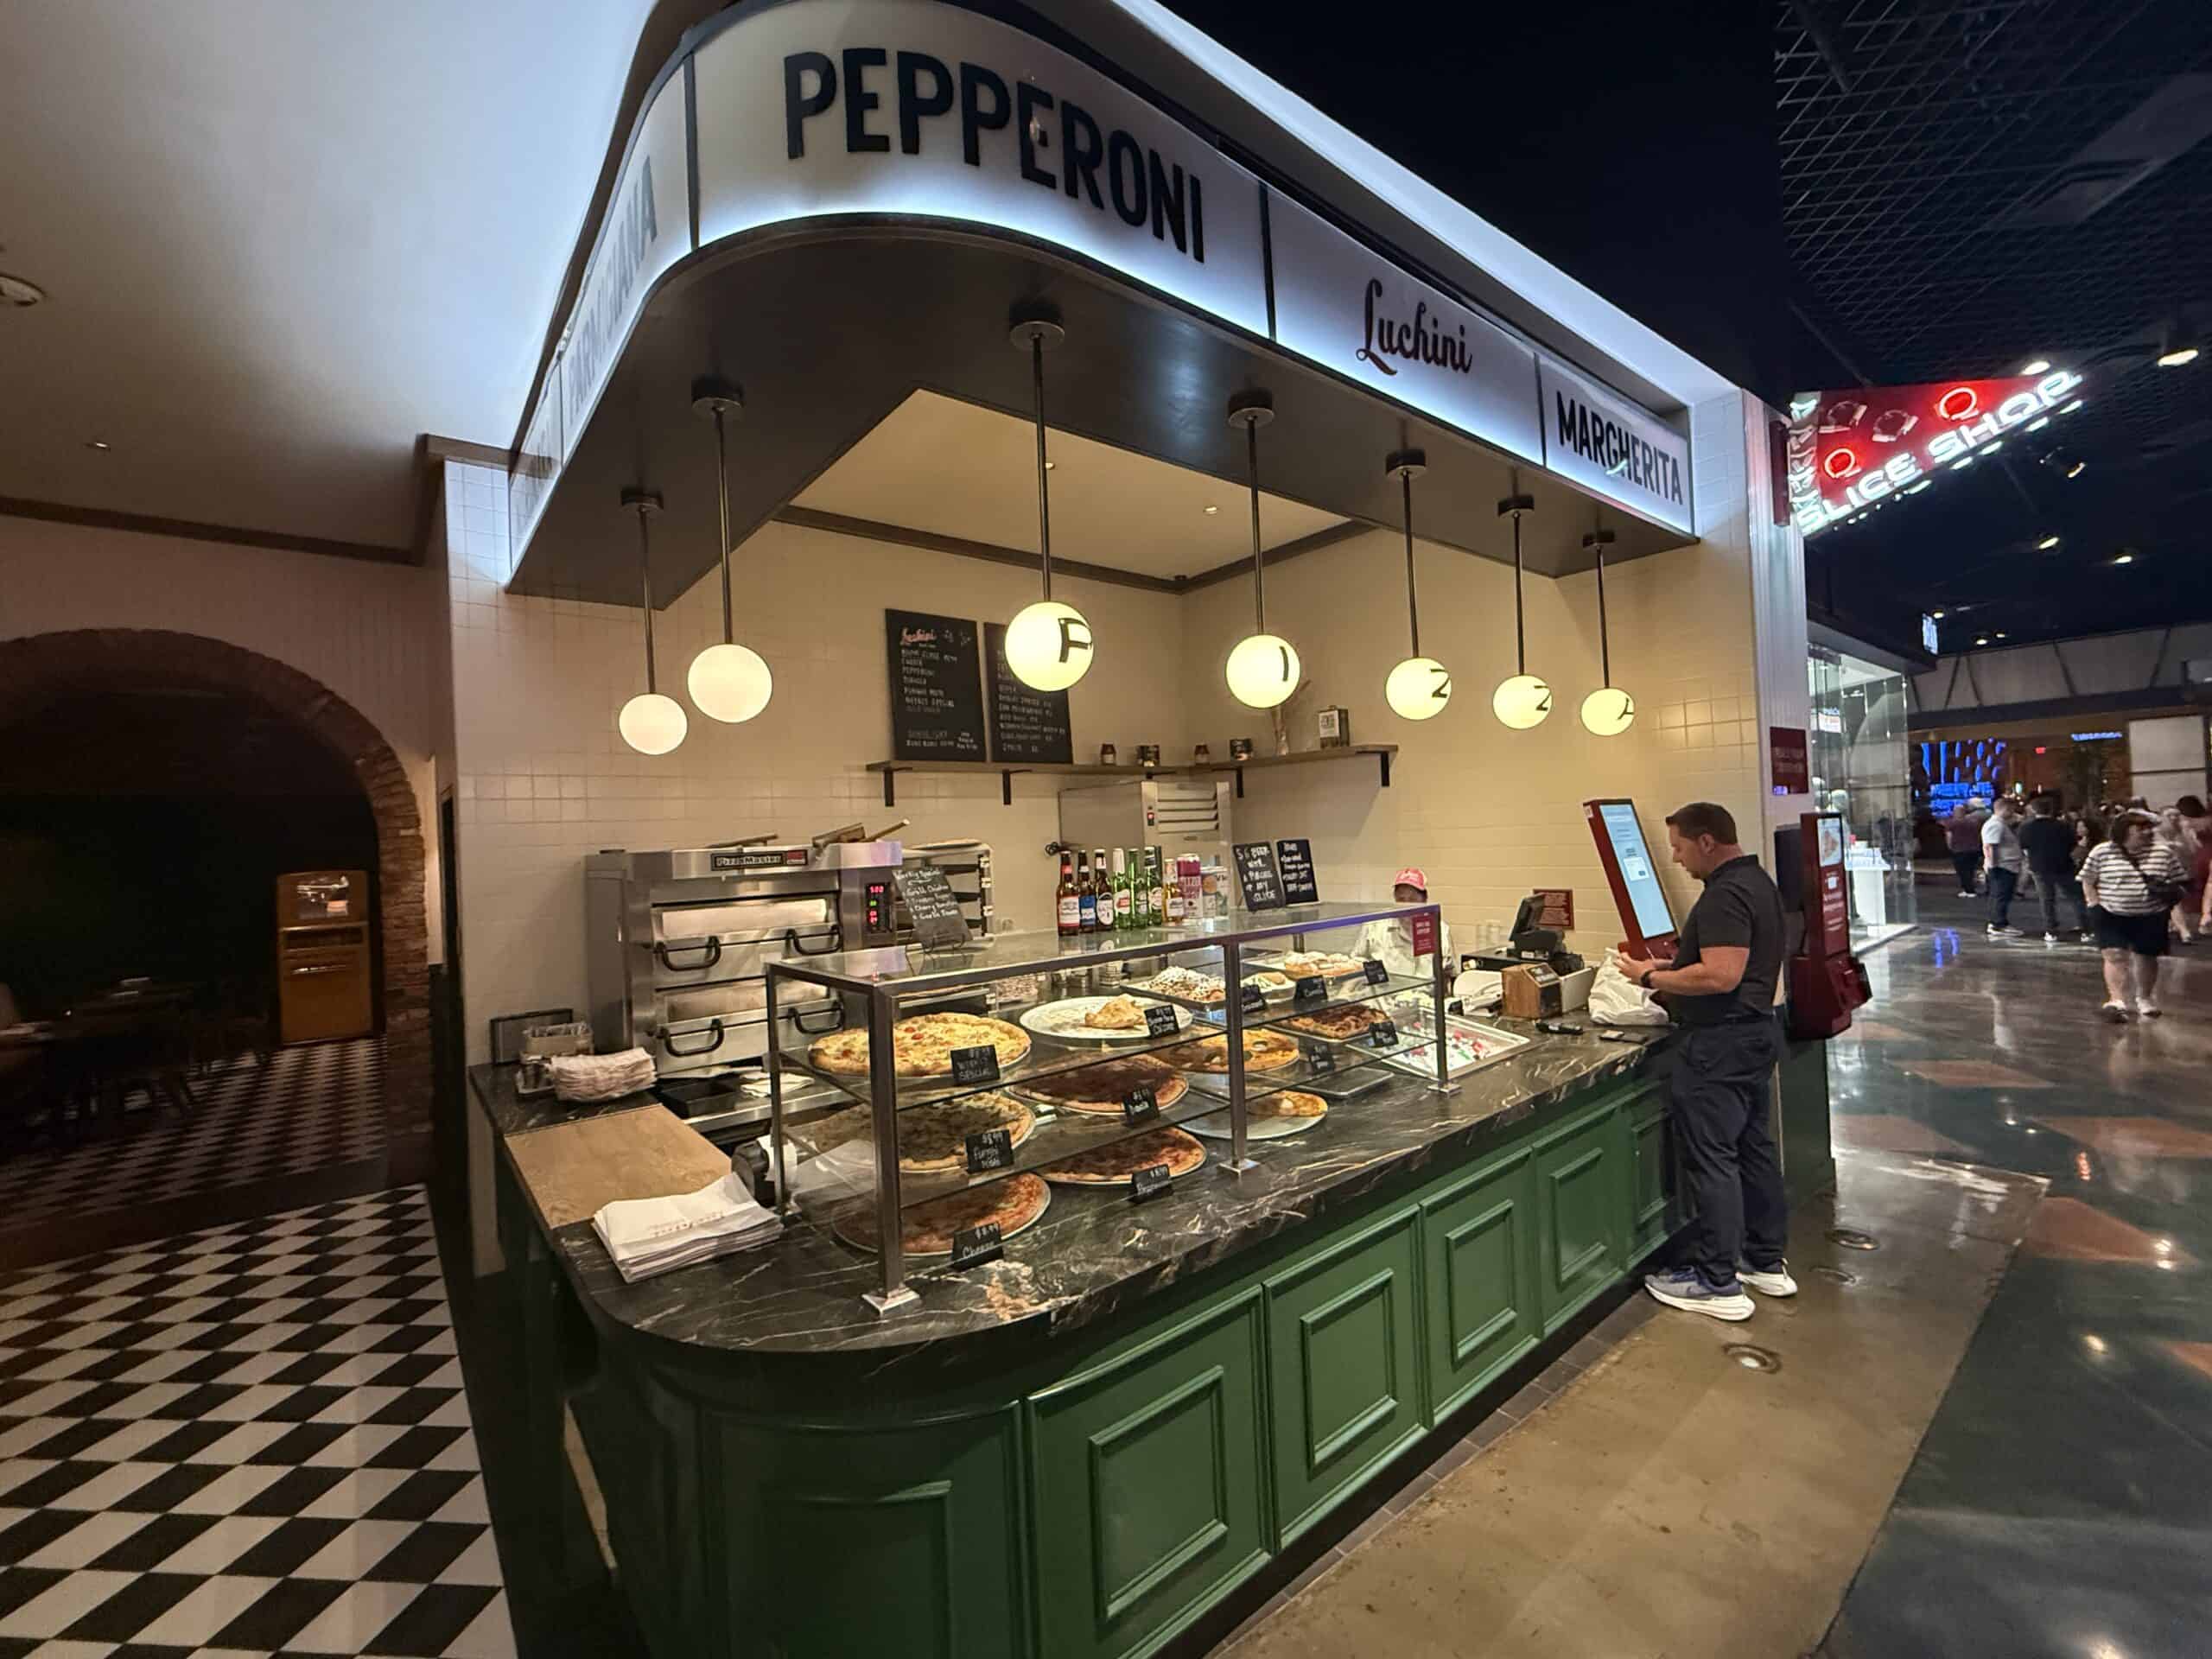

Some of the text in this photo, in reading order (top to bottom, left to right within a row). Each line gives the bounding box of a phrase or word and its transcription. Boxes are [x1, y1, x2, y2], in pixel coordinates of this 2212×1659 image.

[785, 48, 1205, 263] PEPPERONI
[1355, 278, 1472, 375] Luchini
[1556, 391, 1683, 505] MARGHERITA
[1796, 371, 2082, 534] SLICE SHOP
